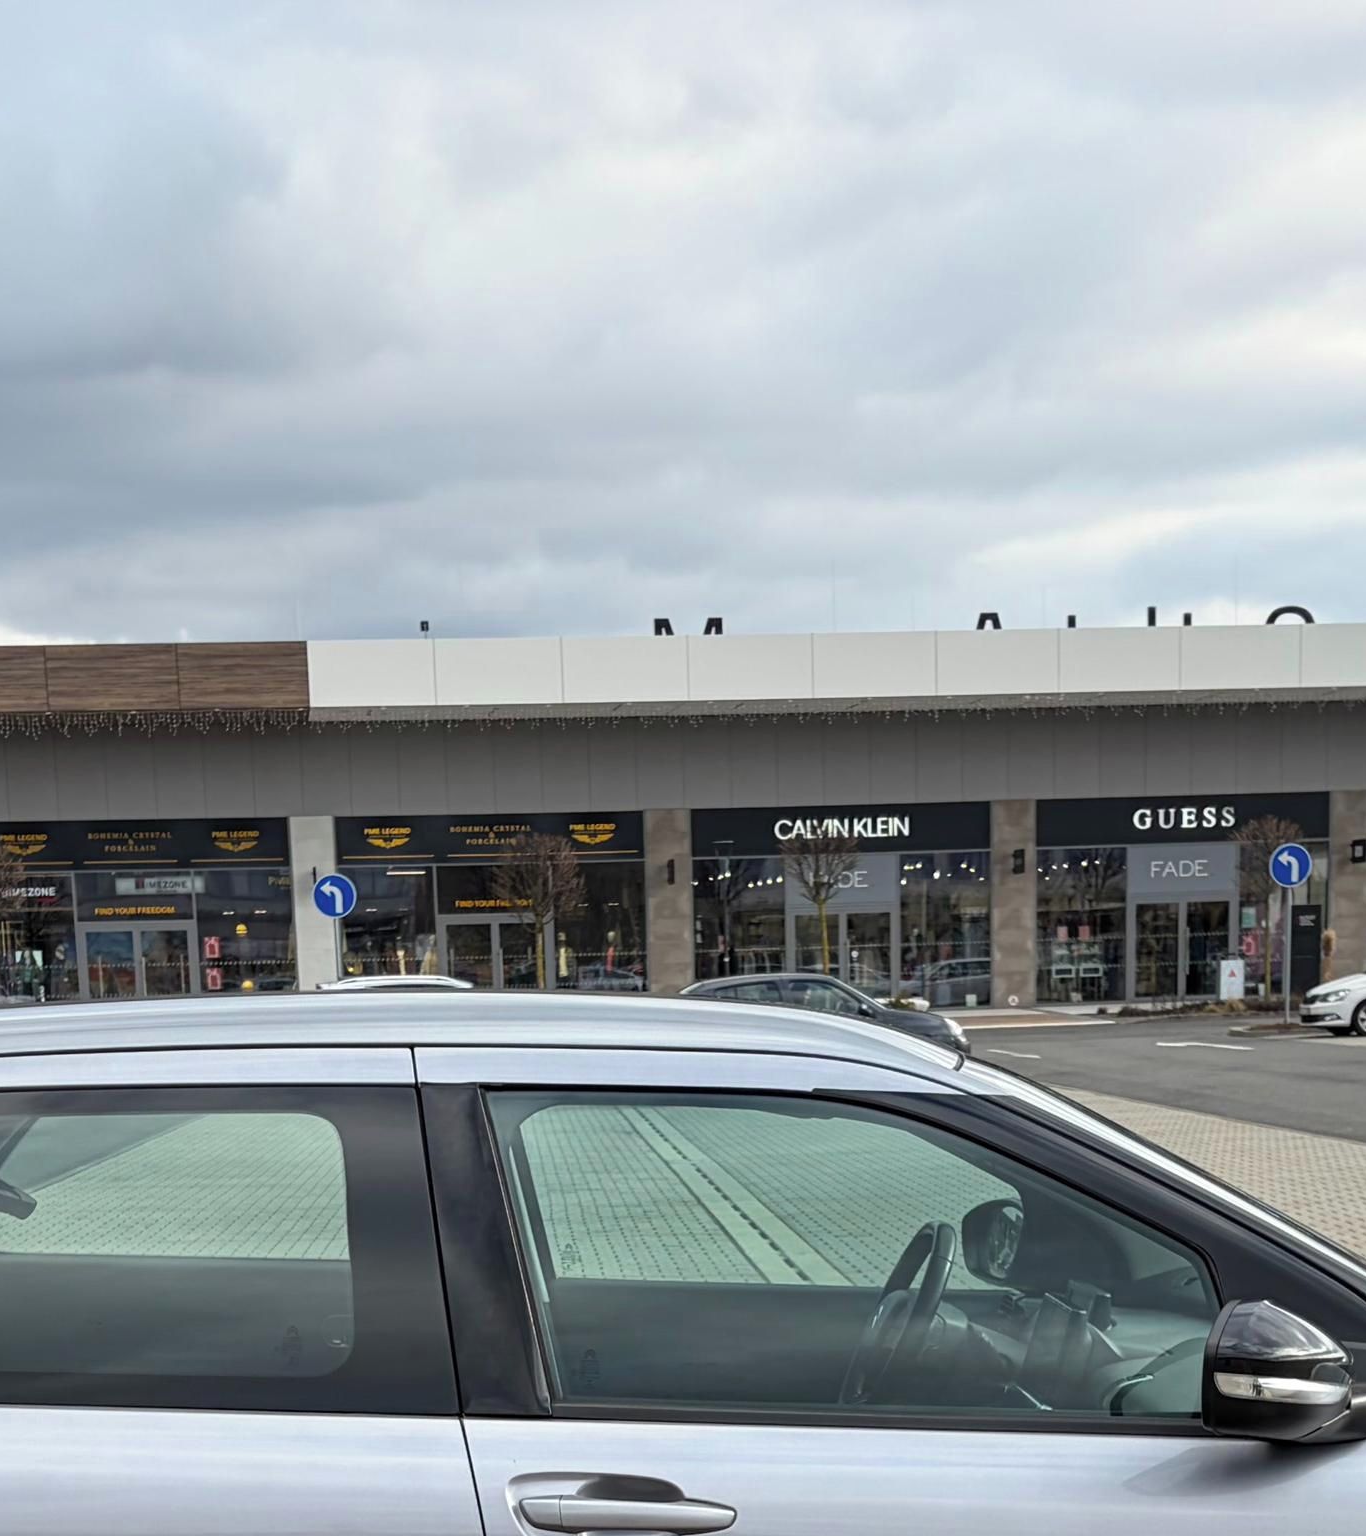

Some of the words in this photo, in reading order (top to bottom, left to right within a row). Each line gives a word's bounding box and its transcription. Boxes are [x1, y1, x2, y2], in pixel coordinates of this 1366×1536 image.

[774, 818, 849, 840] CALVIN
[853, 816, 910, 838] KLEIN
[1132, 806, 1236, 830] GUESS
[87, 832, 129, 840] BOHEMIA
[1150, 859, 1209, 878] FADE
